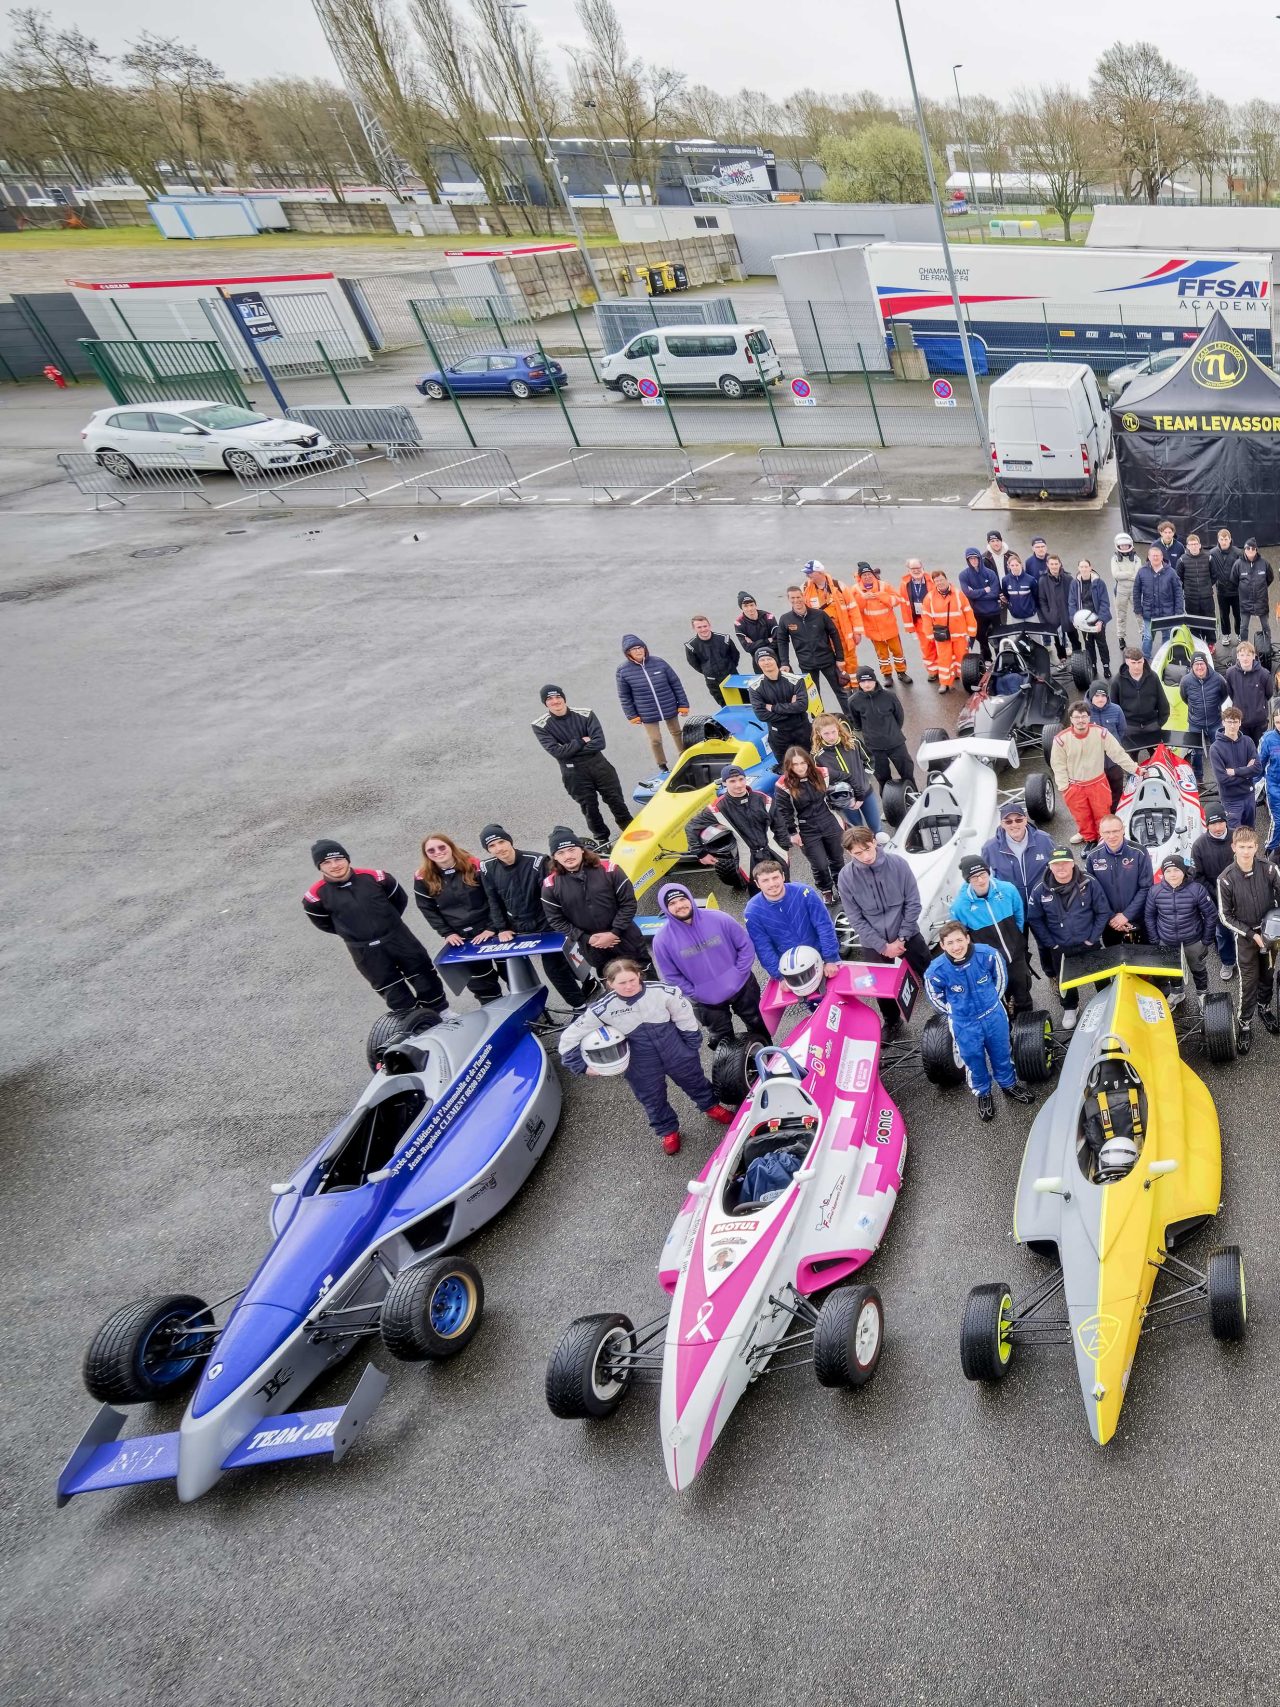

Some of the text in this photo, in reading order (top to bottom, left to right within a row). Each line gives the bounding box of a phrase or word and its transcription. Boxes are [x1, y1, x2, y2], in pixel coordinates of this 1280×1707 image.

[1178, 279, 1258, 298] FFSA
[1179, 300, 1269, 312] ACADEMY
[1152, 415, 1198, 431] TEAM
[477, 939, 541, 954] TEAM JBC
[473, 1043, 493, 1071] l'Industrie
[465, 1074, 472, 1083] et
[468, 1067, 477, 1077] de
[436, 1080, 468, 1117] l'Automobile
[408, 1129, 442, 1171] Jean-Baptiste
[439, 1095, 467, 1130] CLEMENT
[464, 1080, 478, 1098] 08200
[476, 1059, 492, 1082] SEDAN
[432, 1115, 441, 1125] de
[877, 1109, 893, 1144] SONIC
[413, 1123, 435, 1148] Métiers
[404, 1145, 417, 1158] des
[391, 1157, 407, 1178] ycée
[713, 1221, 755, 1234] MOTUL
[247, 1424, 309, 1450] TEAM
